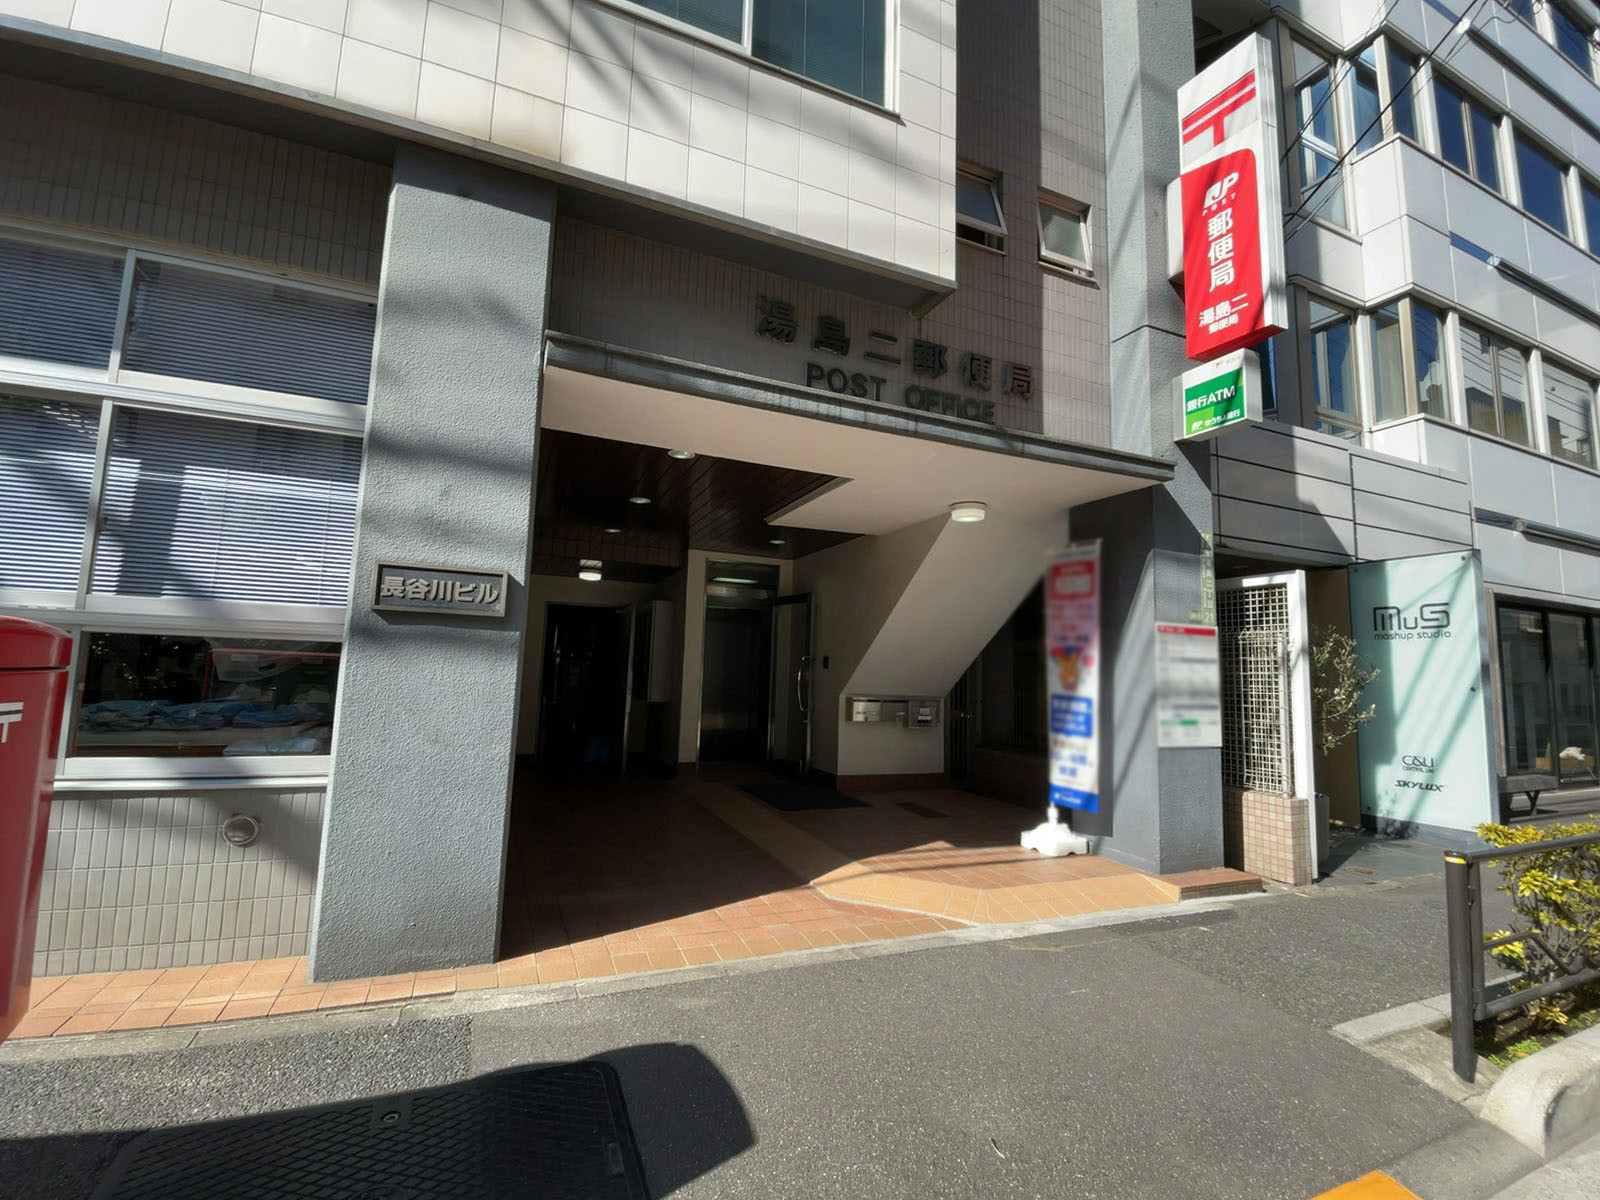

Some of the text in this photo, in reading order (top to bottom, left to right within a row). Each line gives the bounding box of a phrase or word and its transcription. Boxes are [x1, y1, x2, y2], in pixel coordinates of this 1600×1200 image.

[1208, 207, 1235, 292] 郵便局
[1199, 293, 1248, 328] 湯島二
[755, 295, 1034, 402] 湯島二郵便局
[805, 361, 996, 426] POST OFFICE
[381, 576, 499, 604] 長谷川ビル
[1374, 630, 1452, 641] mashup studio
[1395, 780, 1444, 792] SKYLUX
